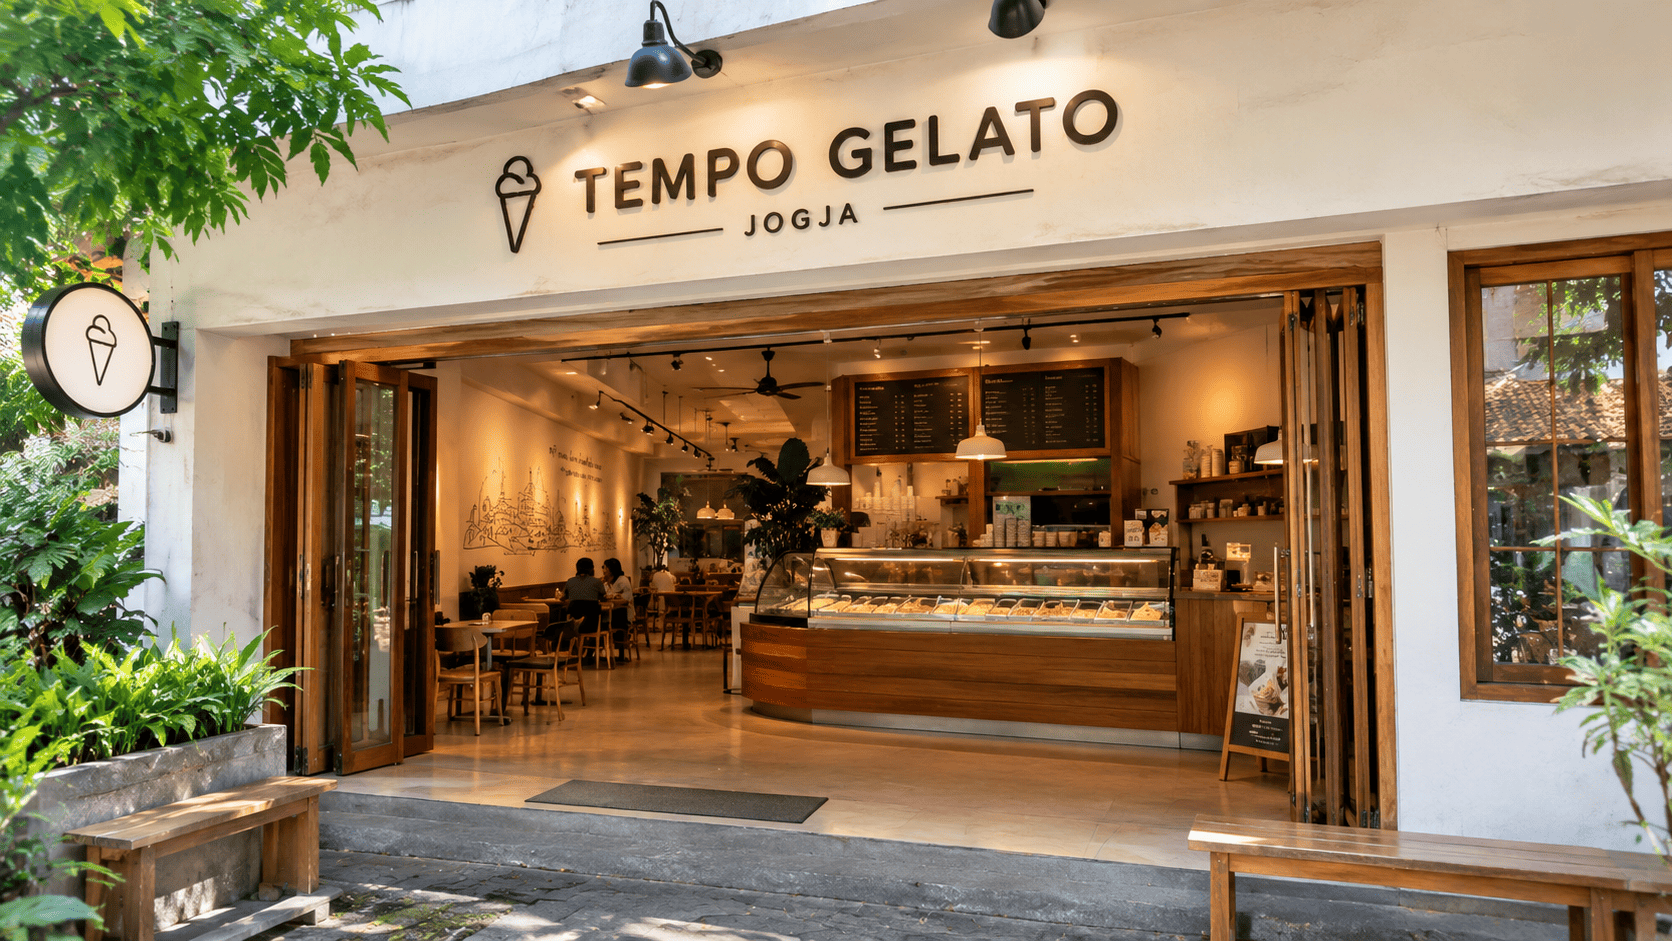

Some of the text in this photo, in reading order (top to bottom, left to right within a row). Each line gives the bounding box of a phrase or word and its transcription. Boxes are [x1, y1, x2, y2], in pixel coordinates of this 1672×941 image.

[575, 89, 1119, 214] TEMPO GELATO
[744, 203, 859, 237] JOGJA
